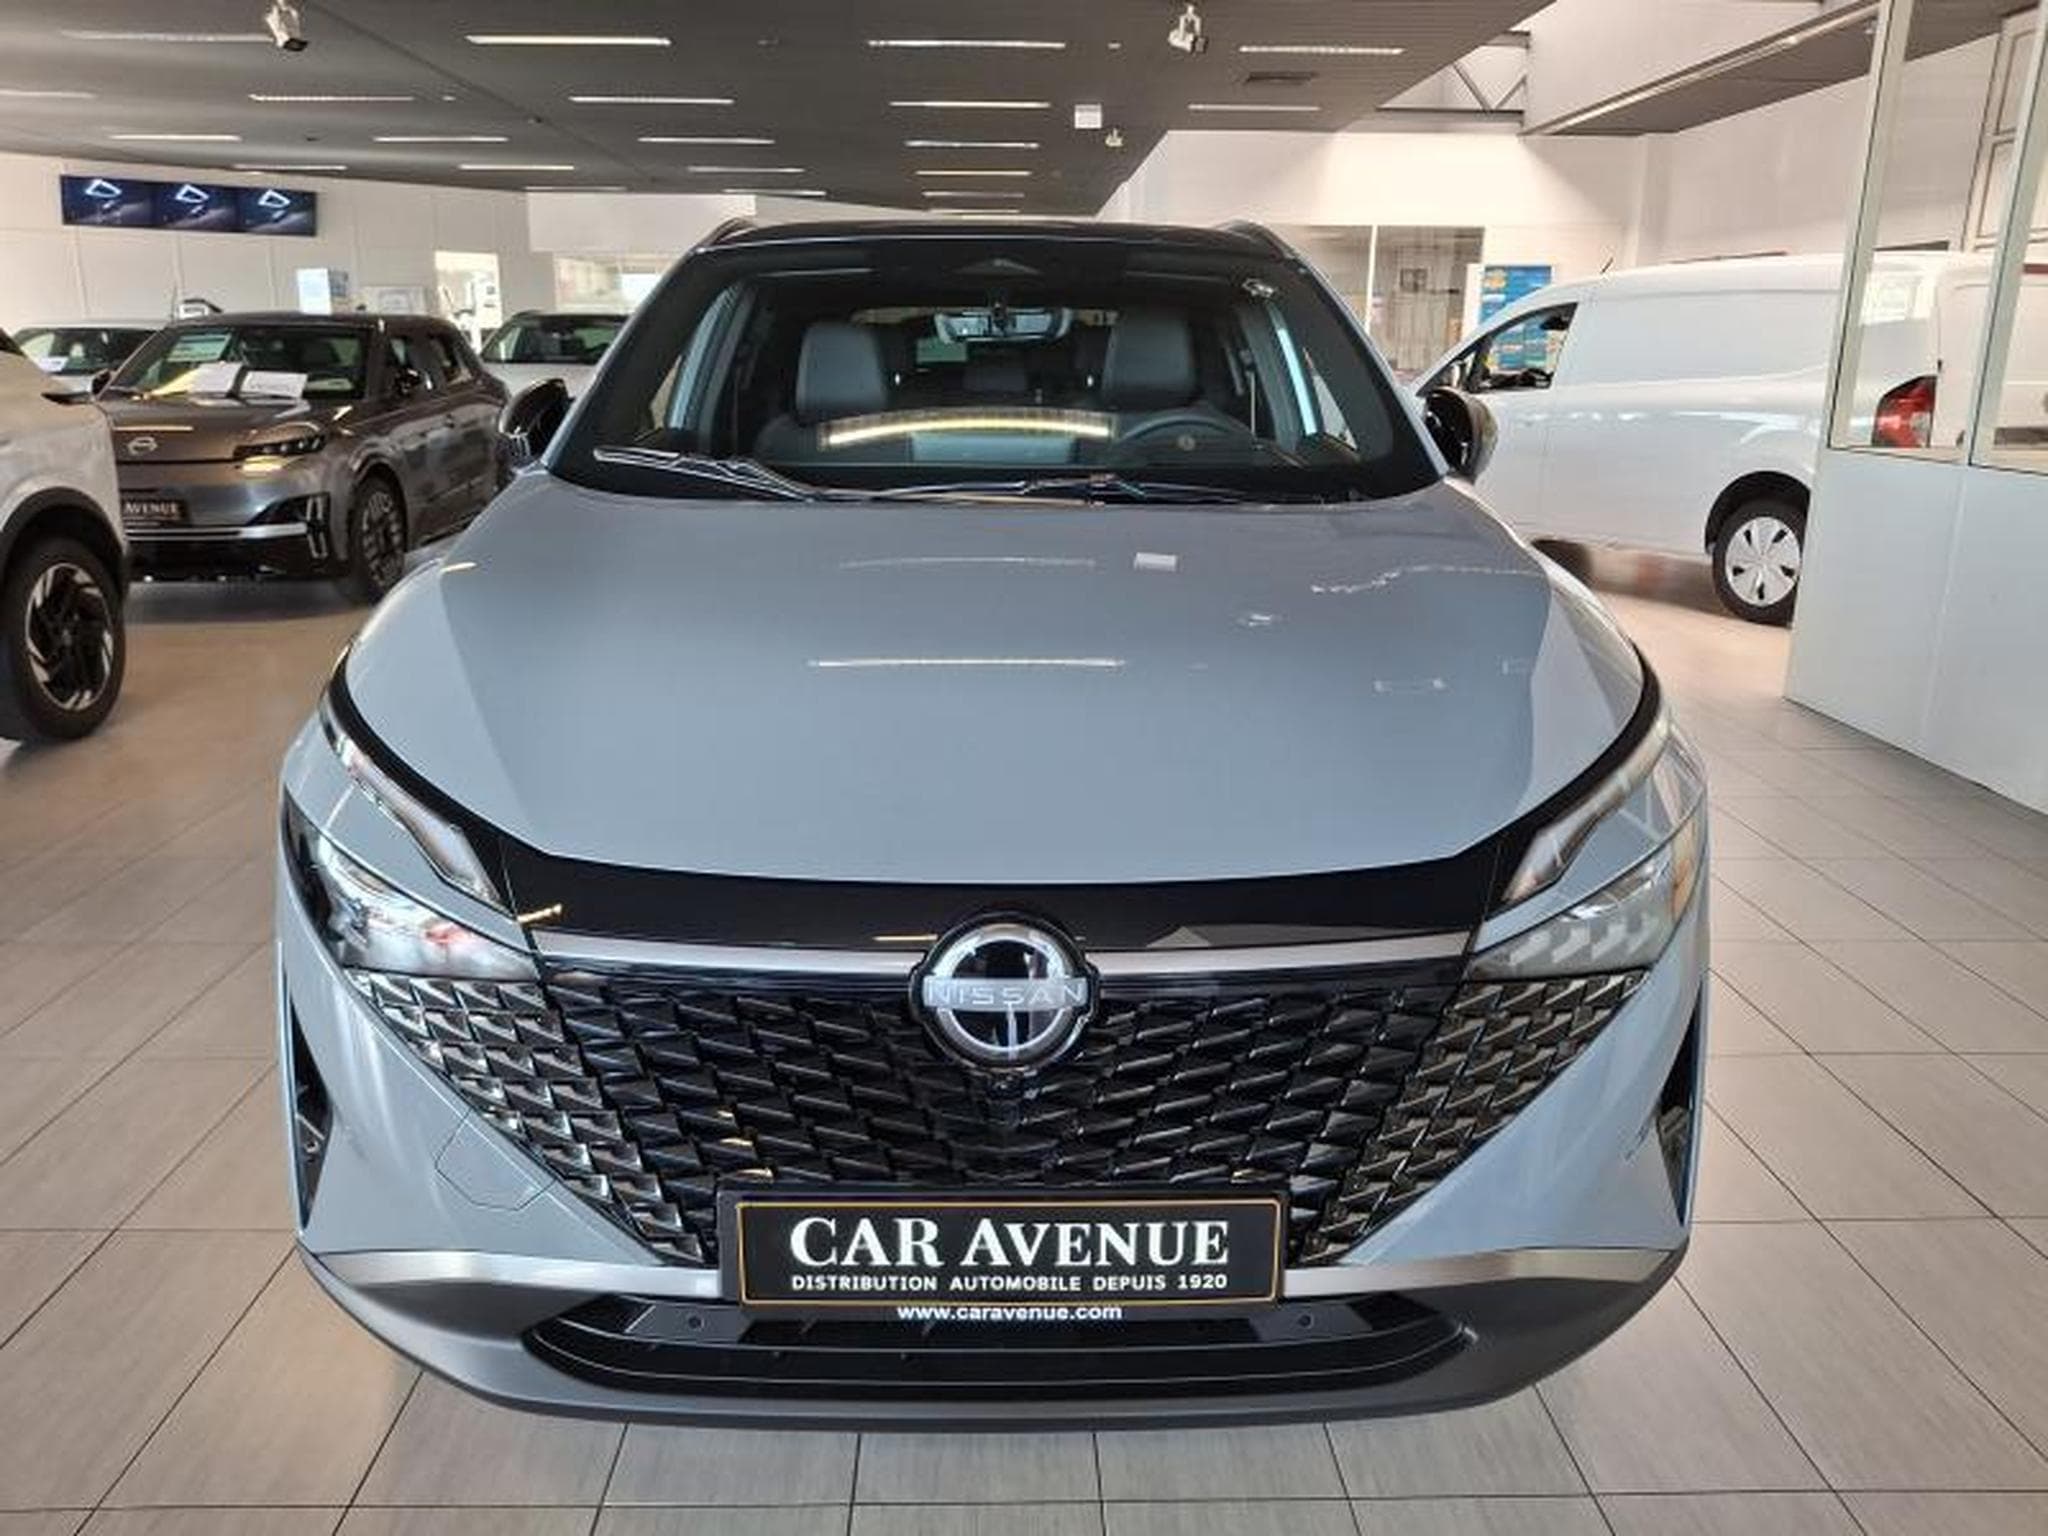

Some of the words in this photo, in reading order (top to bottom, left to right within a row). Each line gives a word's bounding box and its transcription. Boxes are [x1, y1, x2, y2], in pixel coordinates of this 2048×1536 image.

[928, 982, 1084, 1005] NISSAN
[790, 1216, 945, 1267] CAR
[959, 1217, 1229, 1267] AVENUE
[792, 1275, 938, 1291] DISTRIBUTION
[949, 1275, 1081, 1291] AUTOMOBILE
[1093, 1274, 1167, 1291] DEPUIS
[1177, 1274, 1228, 1290] 1920
[897, 1306, 1123, 1321] www.caravenue.com
